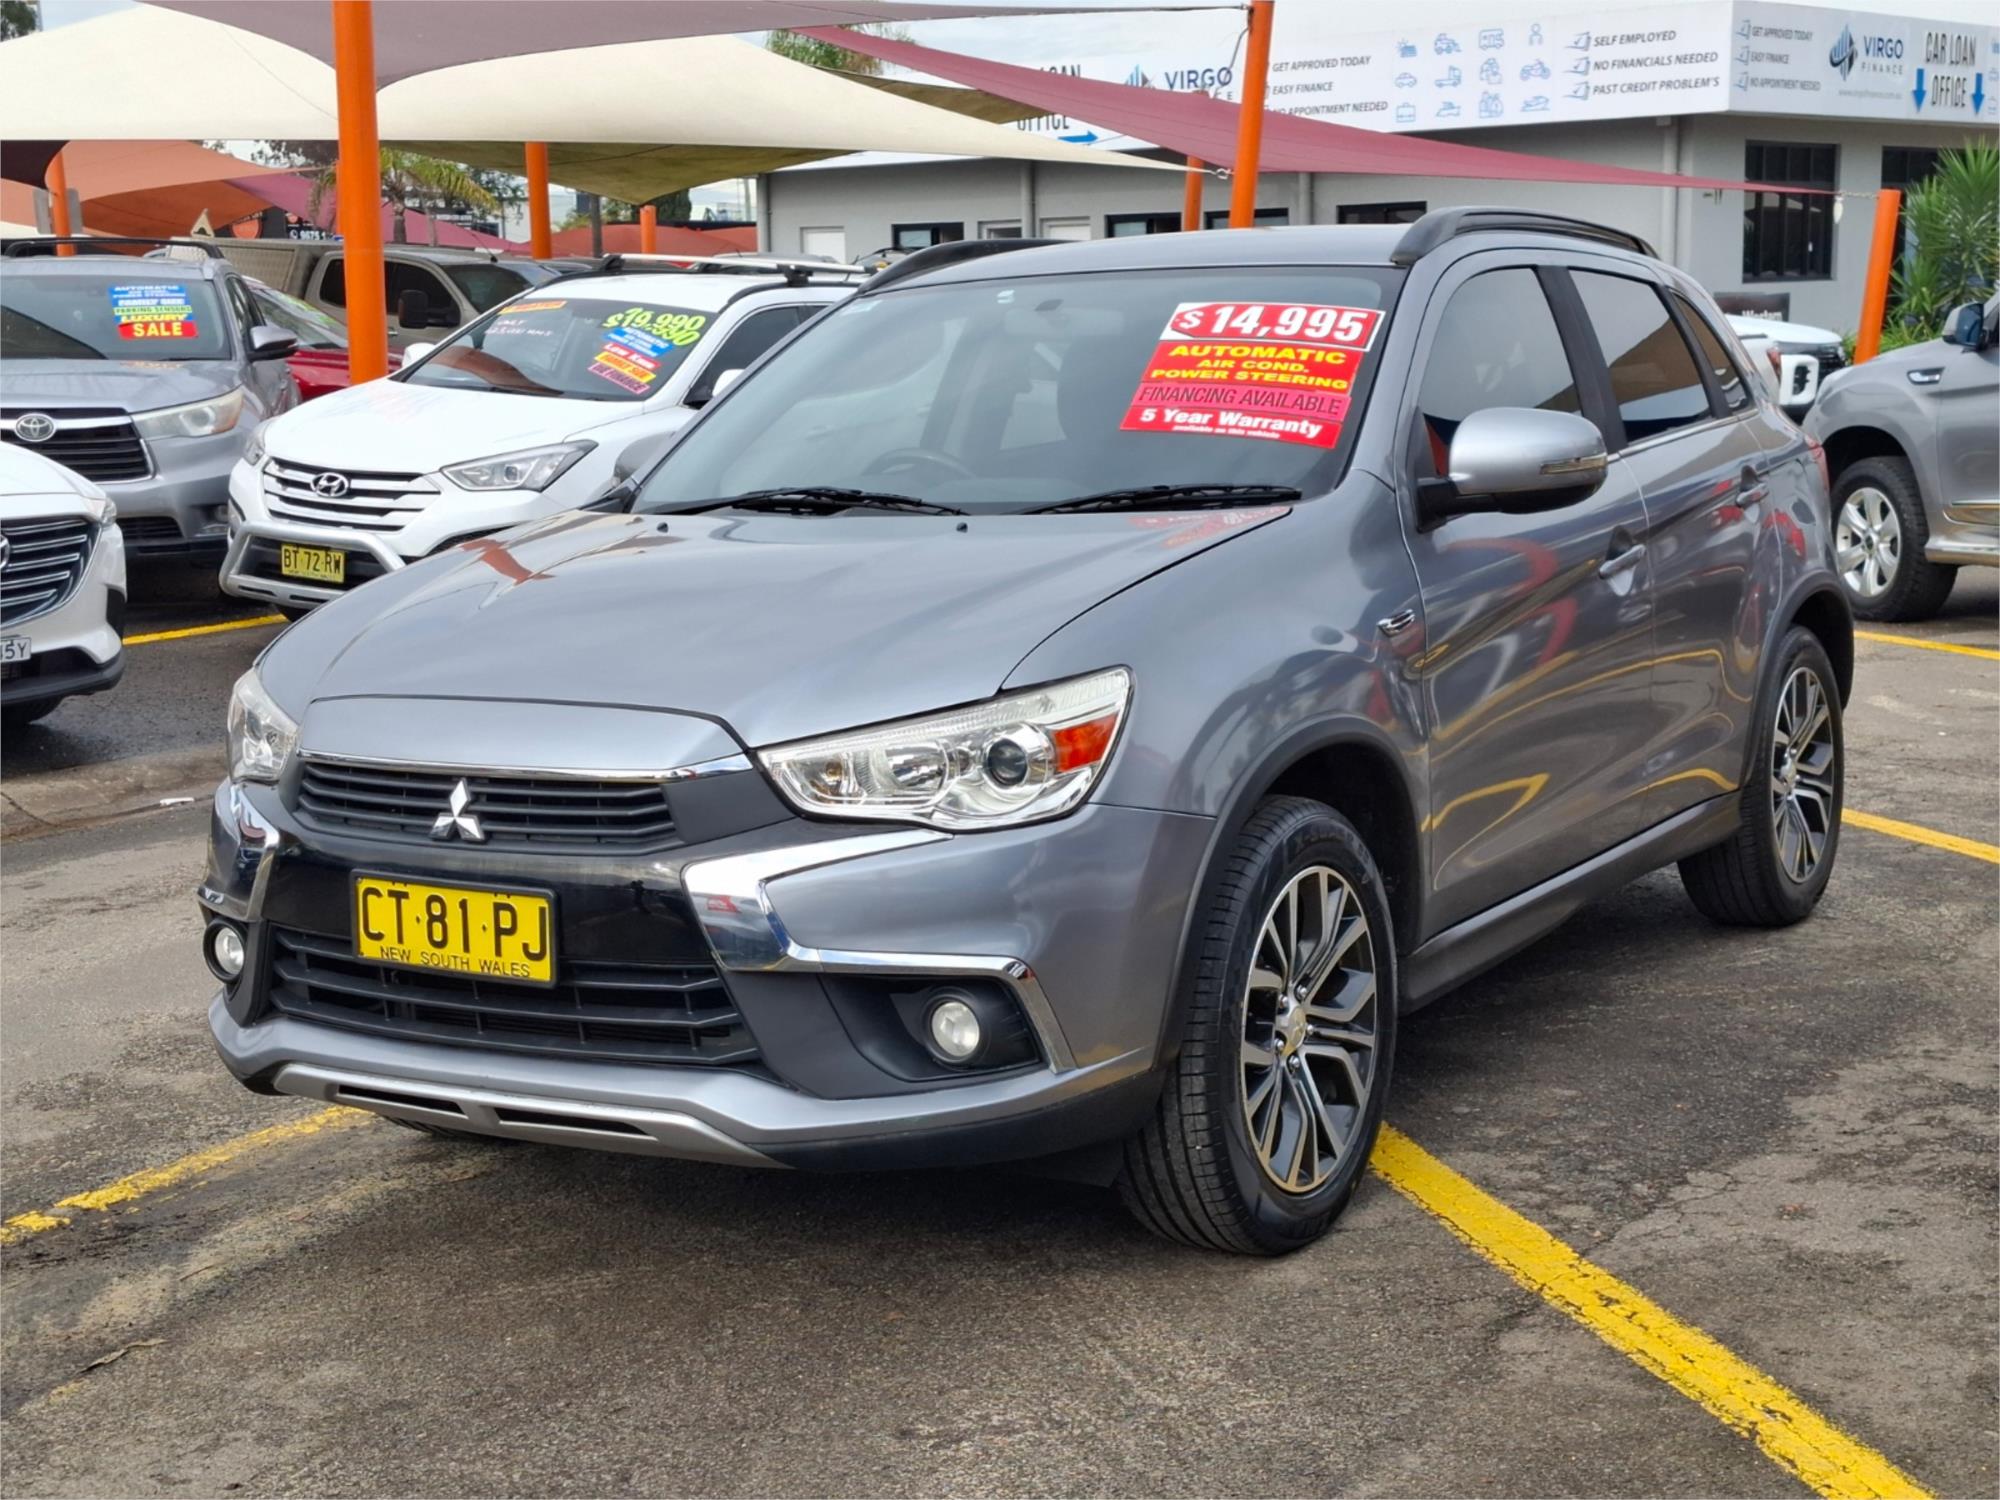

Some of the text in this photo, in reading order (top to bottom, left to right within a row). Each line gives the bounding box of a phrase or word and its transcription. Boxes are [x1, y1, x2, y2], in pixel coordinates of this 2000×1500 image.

[1594, 30, 1677, 48] SELF EMPLOYED
[1864, 35, 1904, 59] VIRGO
[1925, 31, 1977, 66] CAR LOAN
[1272, 56, 1371, 72] GET APPROVED TODAY
[1593, 52, 1718, 71] NO FINANCIALS NEEDED
[1861, 61, 1904, 75] FINANCE
[1165, 67, 1232, 90] VIRGO
[1272, 81, 1334, 95] EASY FINANCE
[1593, 76, 1720, 95] PAST CREDIT PROBLEM'S
[1931, 75, 1967, 108] OFFICE
[1288, 103, 1351, 115] APPOINTMENT
[1352, 101, 1389, 112] NEEDED
[133, 321, 183, 337] SALE
[1168, 344, 1348, 365] AUTOMATIC
[1197, 359, 1310, 373] AIR COND.
[1150, 368, 1348, 390] POWER STEERING
[1138, 386, 1342, 416] FINANCING AVAILABLE
[1140, 408, 1323, 439] 5 Year Warranty
[1, 641, 27, 660] 5Y
[380, 945, 531, 978] NEW SOUTH WALES
